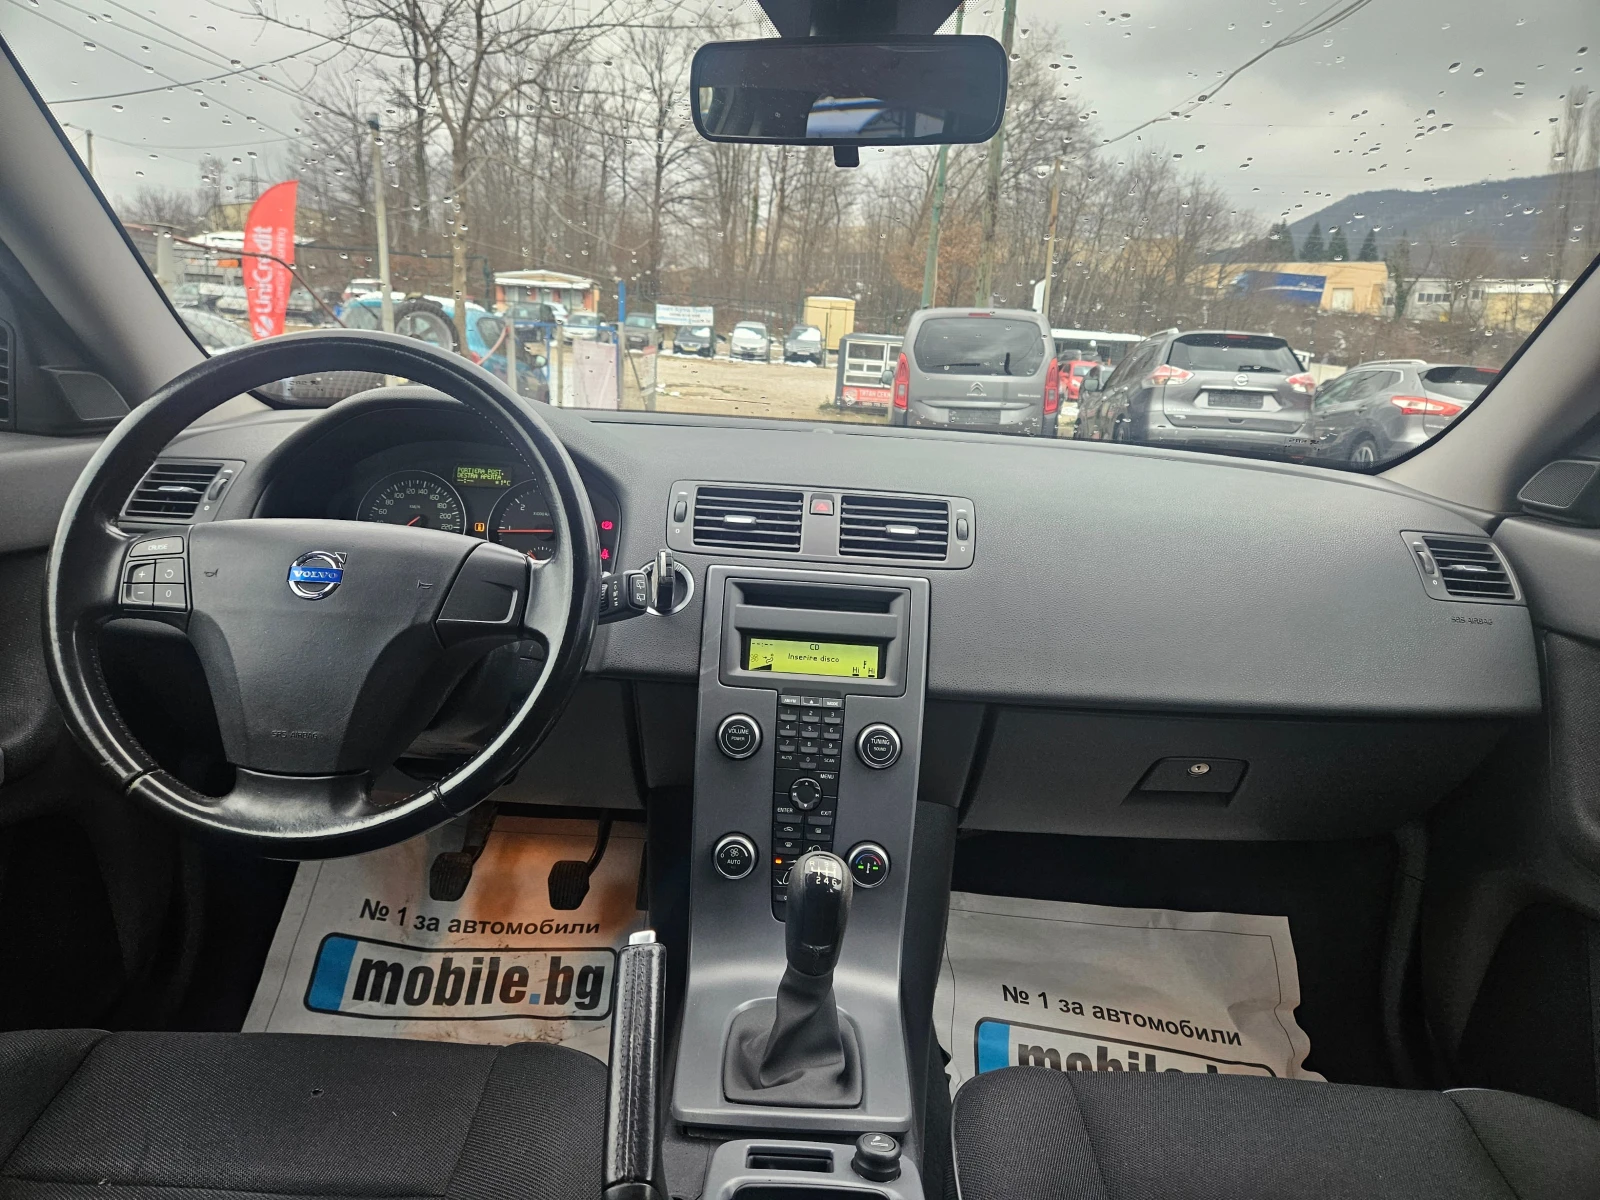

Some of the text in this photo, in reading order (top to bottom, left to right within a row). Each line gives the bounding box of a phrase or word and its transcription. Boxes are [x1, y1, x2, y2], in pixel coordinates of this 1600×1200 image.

[292, 570, 339, 579] VOLVO
[809, 643, 820, 651] CD
[788, 653, 840, 663] Inserire disco
[815, 876, 821, 885] 2
[823, 877, 830, 885] 4
[359, 898, 601, 935] № 1 за автомобили
[352, 956, 606, 1010] mobile.bg
[1002, 984, 1243, 1047] № 1 за автомобили
